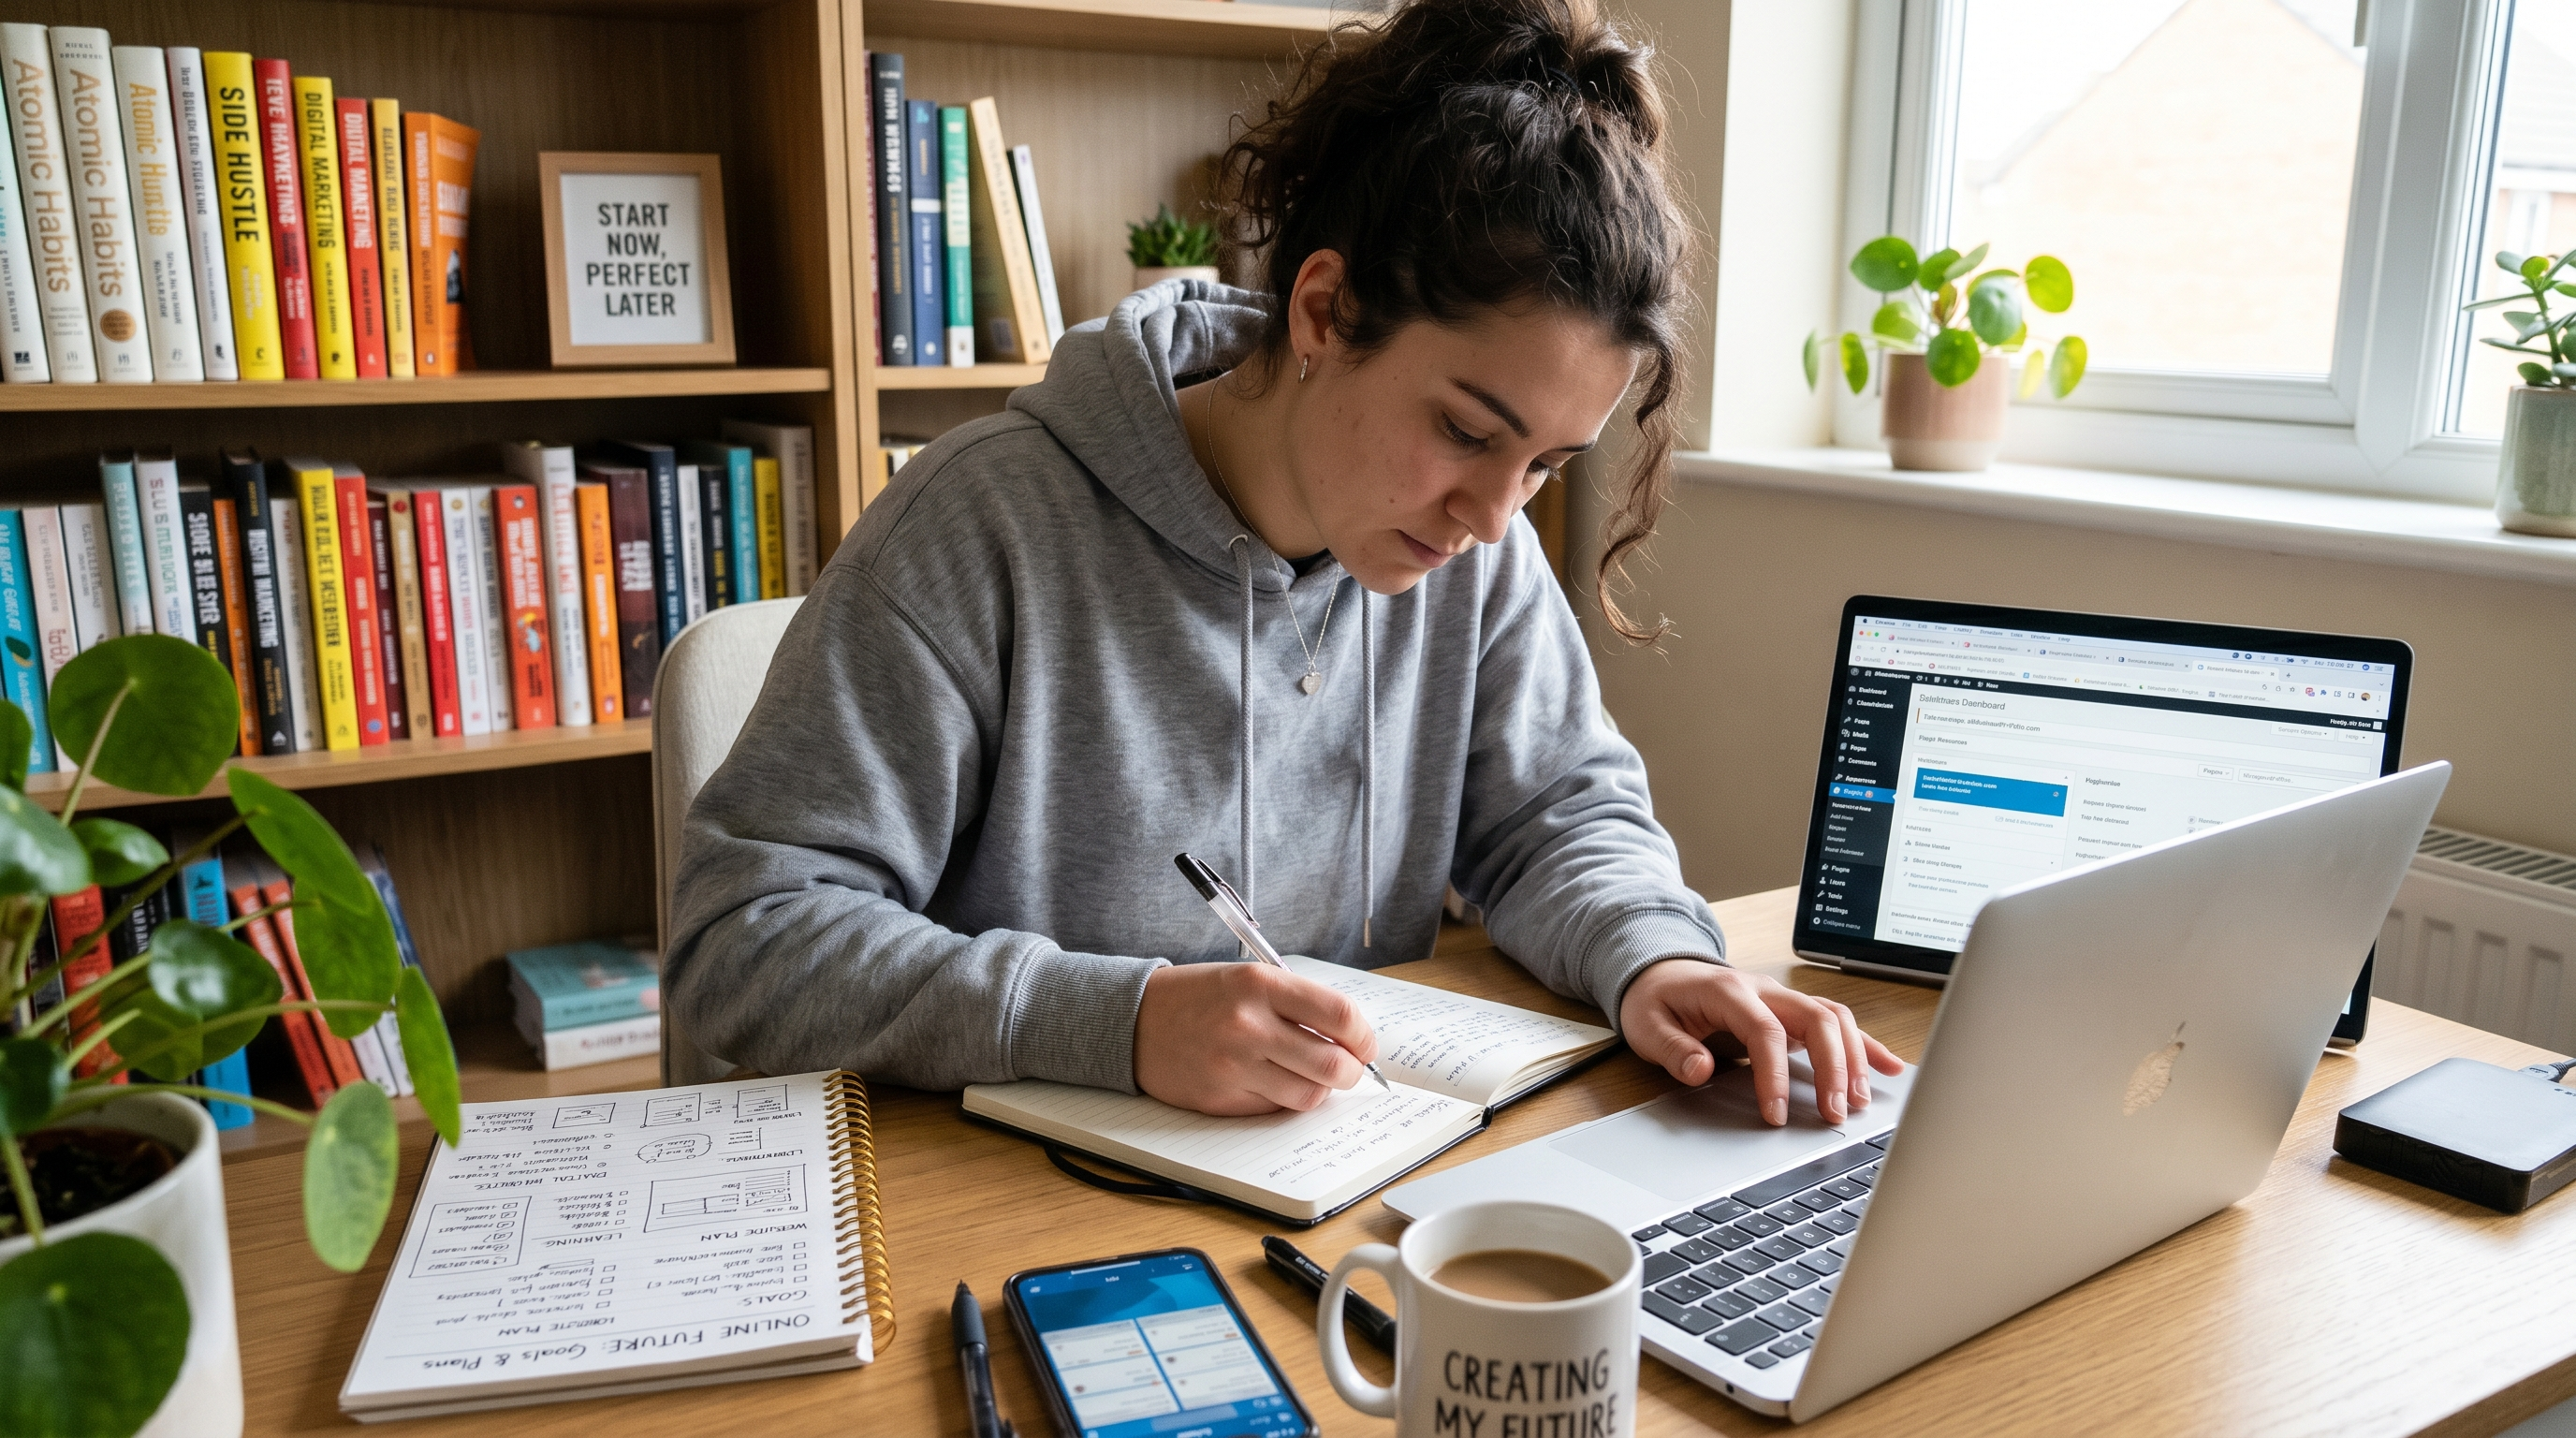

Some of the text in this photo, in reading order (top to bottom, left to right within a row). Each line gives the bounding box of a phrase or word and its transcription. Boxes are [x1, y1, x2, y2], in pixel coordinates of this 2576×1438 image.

[69, 68, 112, 186] Atomic
[129, 81, 161, 154] Atomic
[220, 86, 250, 143] SIDE
[305, 92, 328, 150] DIGITAL
[13, 59, 73, 293] Atomic Habits
[227, 152, 260, 242] HUSTLE
[598, 202, 668, 227] START
[87, 196, 126, 298] Habits
[607, 232, 666, 259] NOW,
[586, 262, 690, 286] PERFECT
[606, 292, 676, 316] LATER
[739, 1289, 808, 1307] GOALS
[720, 1313, 811, 1340] ONLINE
[423, 1356, 482, 1371] Plans
[494, 1353, 511, 1367] &
[522, 1343, 587, 1362] Goals
[1443, 1348, 1610, 1402] CREATING
[1435, 1397, 1486, 1438] MY
